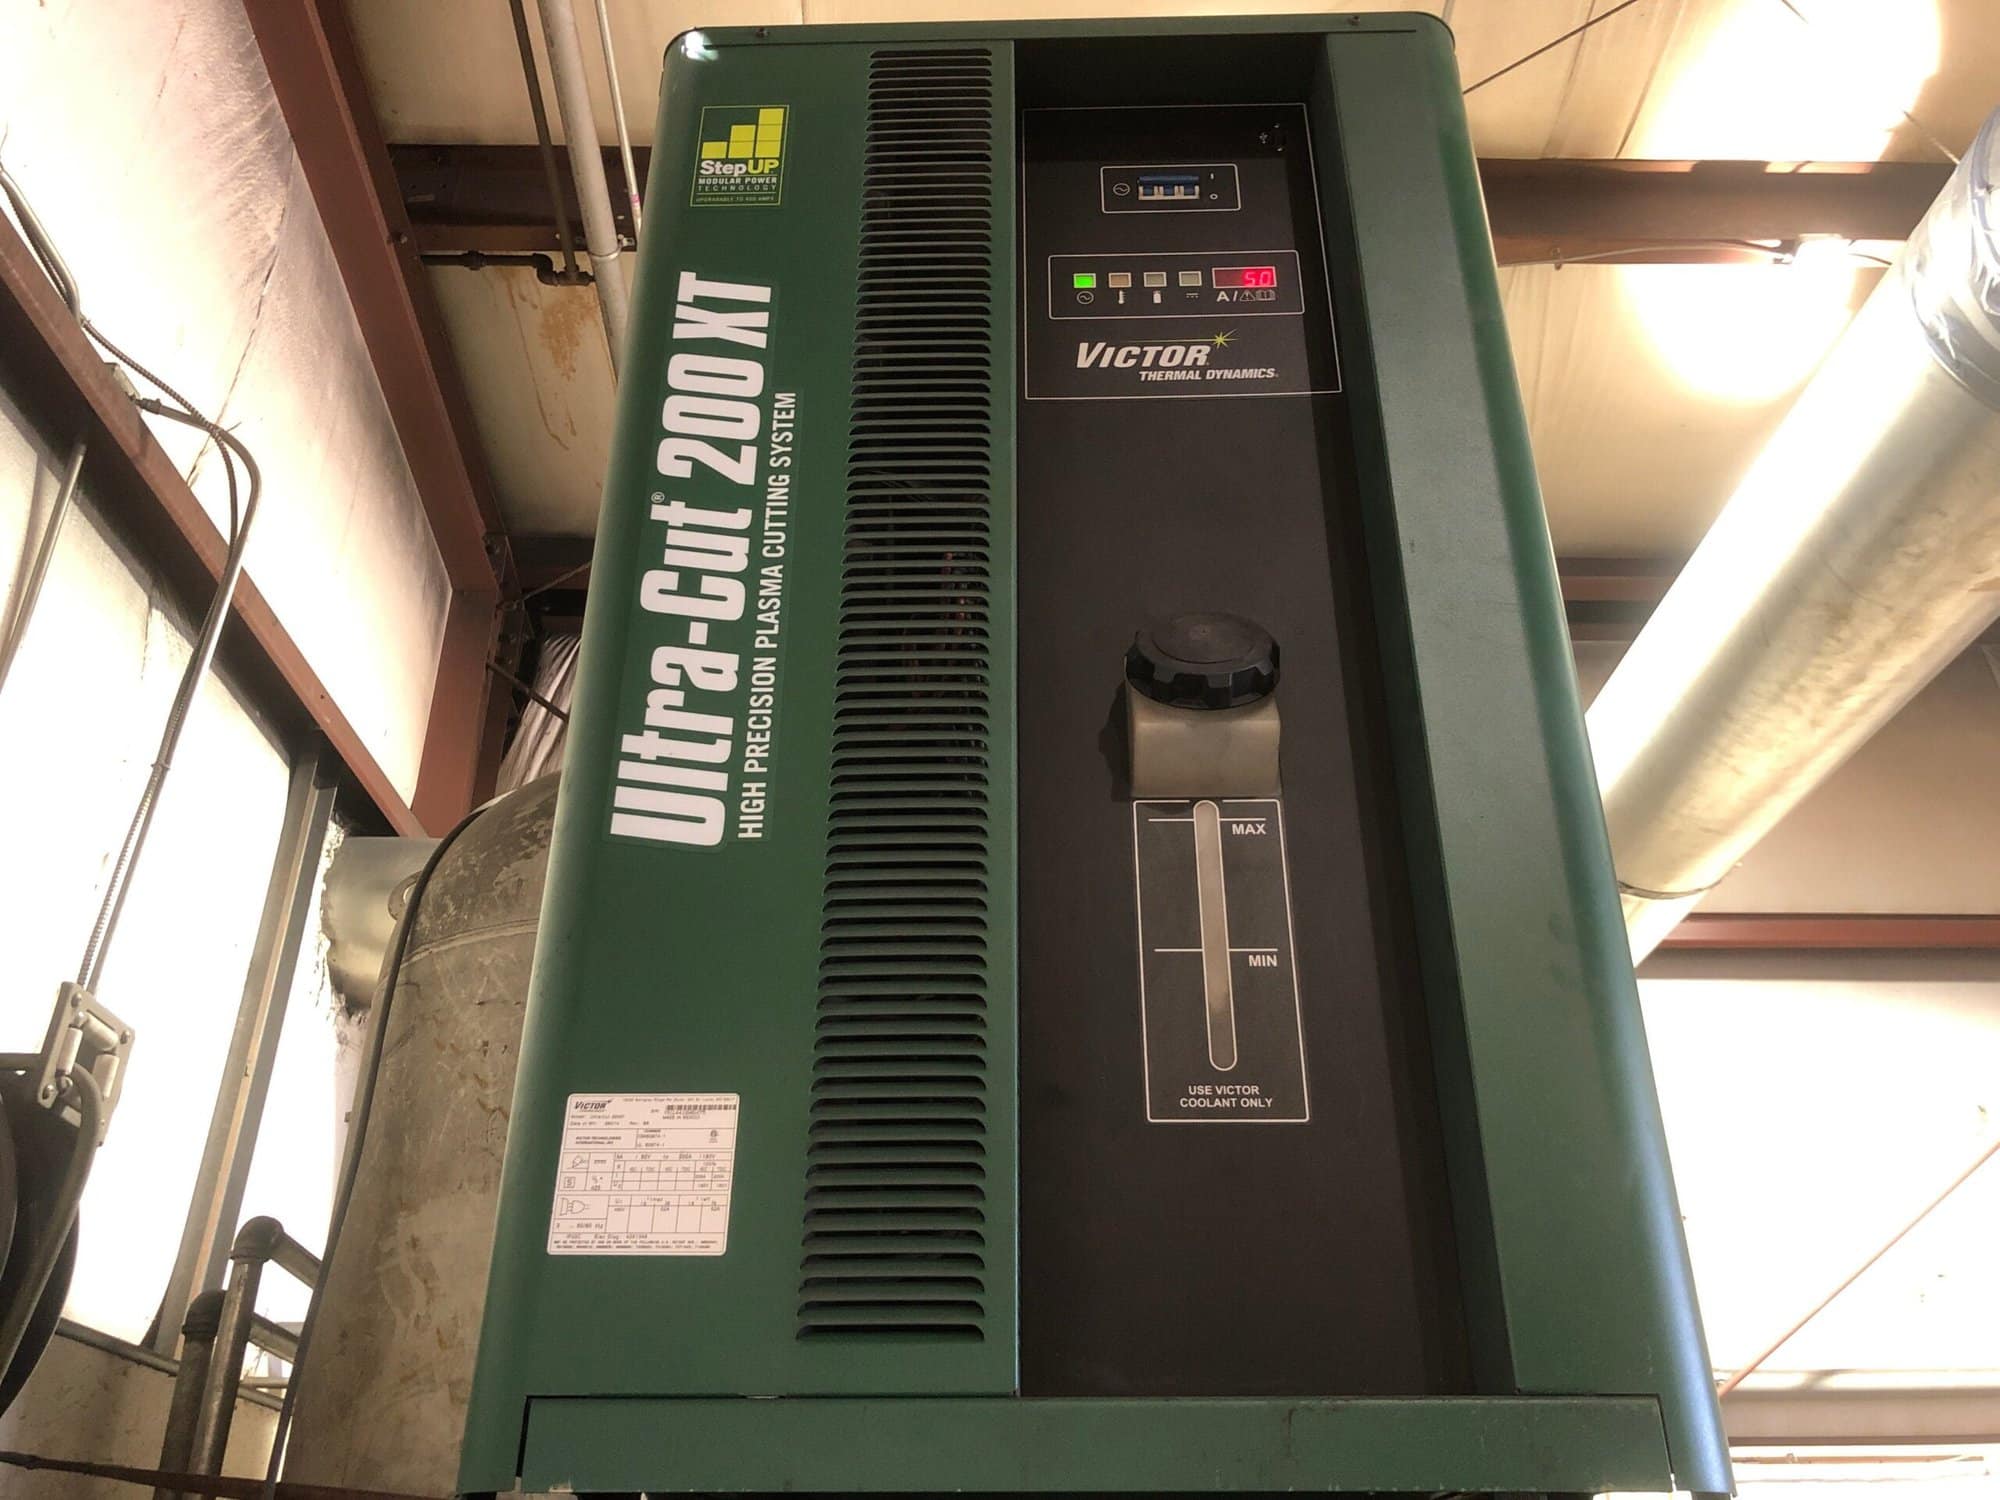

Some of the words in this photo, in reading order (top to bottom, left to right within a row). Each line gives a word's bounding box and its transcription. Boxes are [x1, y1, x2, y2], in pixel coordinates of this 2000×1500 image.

[697, 184, 777, 192] TECHNOLOGY
[698, 177, 742, 185] MODULAR
[744, 176, 777, 185] POWER
[672, 271, 772, 349] XT
[1076, 342, 1212, 369] VICTOR
[1139, 370, 1202, 381] THERMAL
[1205, 368, 1276, 380] DYNAMICS
[656, 353, 765, 486] 200
[769, 392, 797, 467] SYSTEM
[762, 474, 791, 558] CUTTING
[754, 564, 784, 649] PLASMA
[743, 656, 777, 773] PRECISION
[738, 781, 767, 839] HIGH
[1231, 823, 1267, 835] MAX
[1248, 954, 1278, 967] MIN
[1188, 1085, 1213, 1096] USE
[1215, 1085, 1260, 1096] VICTOR
[574, 1101, 607, 1110] VICTOR
[1179, 1097, 1238, 1108] COOLANT
[1240, 1097, 1273, 1108] ONLY
